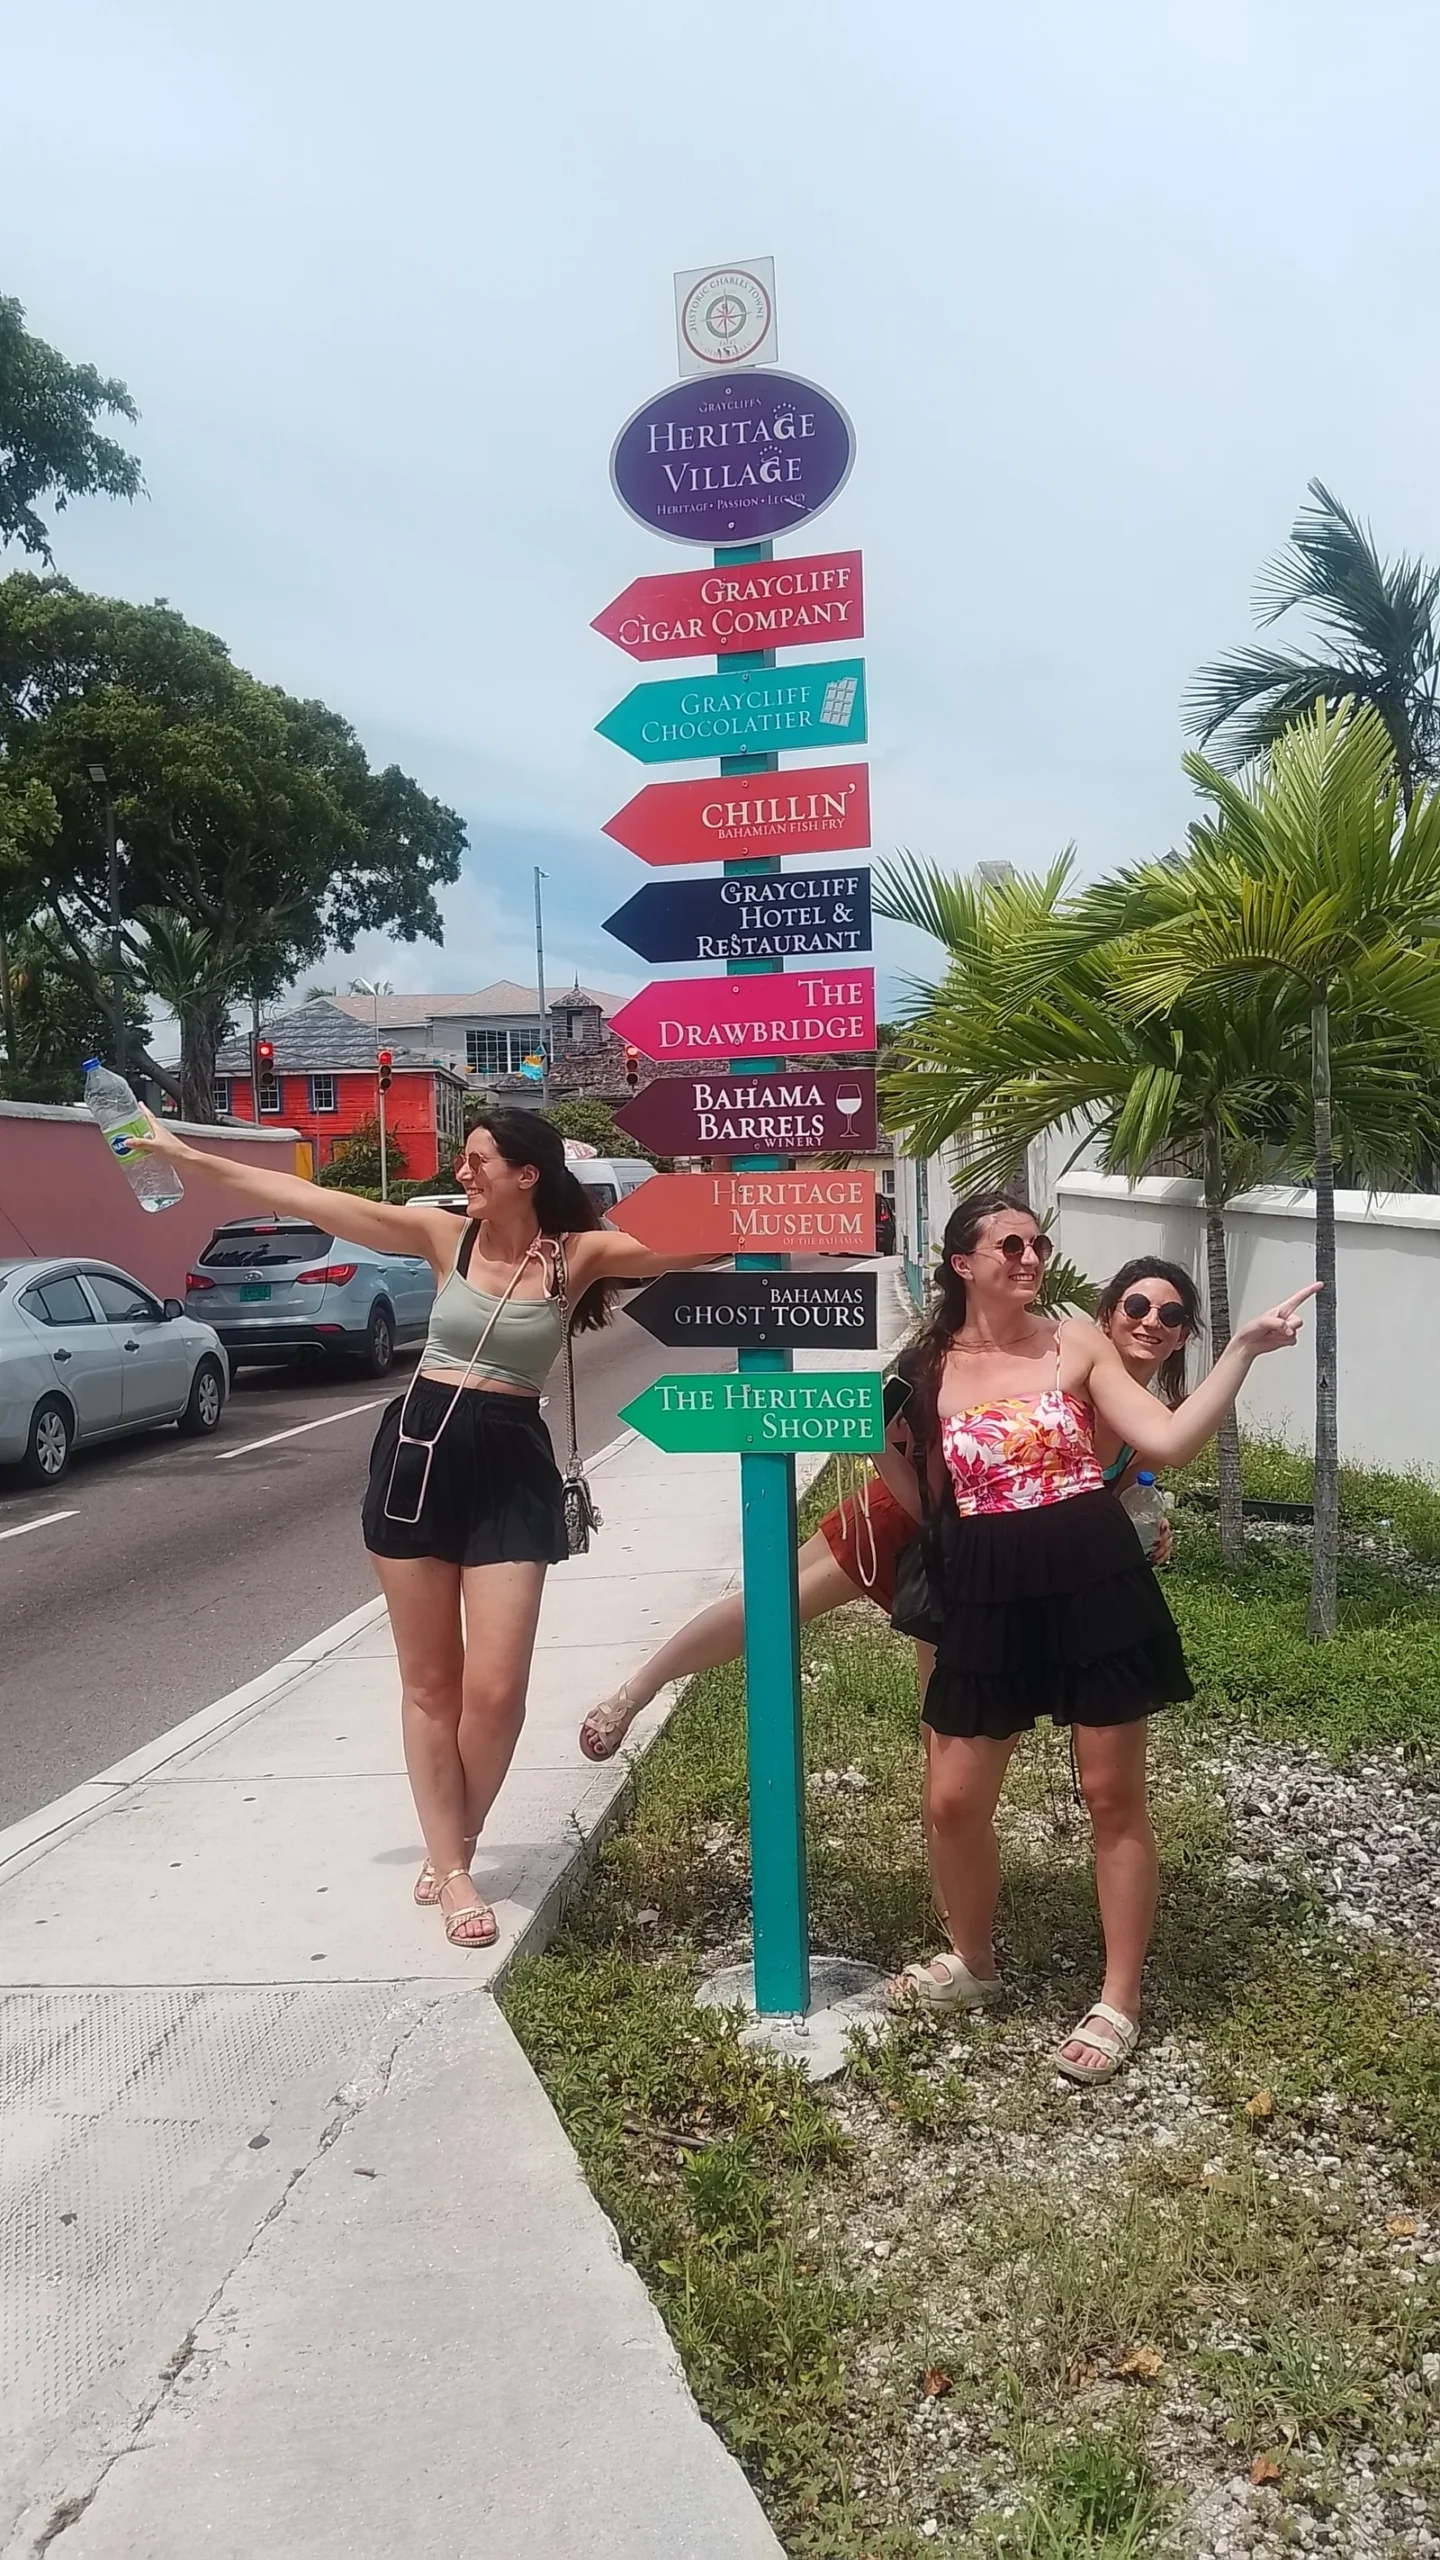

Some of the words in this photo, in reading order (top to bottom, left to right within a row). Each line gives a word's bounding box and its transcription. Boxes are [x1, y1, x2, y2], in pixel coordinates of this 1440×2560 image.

[688, 285, 710, 331] HISTORIC
[709, 277, 748, 289] CHARLES
[748, 287, 764, 320] TOWNE
[647, 410, 816, 454] HERITAGE
[661, 455, 803, 494] VILLAGE
[657, 503, 709, 516] HERITAGE
[717, 497, 759, 510] PASSION
[768, 492, 806, 505] LEGACY
[701, 567, 851, 605] GRAYCLIFF
[619, 617, 707, 645] CIGAR
[711, 600, 853, 636] COMPANY
[681, 686, 811, 715] GRAYCLIFF
[641, 710, 814, 743] CHOCOLATIER
[718, 823, 787, 839] BAHAMIAN
[790, 820, 818, 833] FISH
[821, 818, 846, 830] FRY
[720, 877, 859, 904] GRAYCLIFF
[738, 904, 826, 930] HOTEL
[832, 902, 854, 923] &
[696, 930, 861, 958] RESTAURANT
[797, 978, 863, 1008] THE
[658, 1015, 864, 1048] DRAWBRIDGE
[692, 1083, 825, 1111] BAHAMA
[697, 1113, 825, 1141] BARRELS
[764, 1136, 825, 1148] WINERY
[712, 1179, 864, 1206] HERITAGE
[729, 1208, 864, 1236] MUSEUM
[783, 1237, 794, 1245] OF
[799, 1237, 816, 1245] THE
[819, 1237, 864, 1245] BAHAMAS
[769, 1288, 864, 1304] BAHAMAS
[674, 1305, 765, 1326] GHOST
[771, 1306, 865, 1327] TOURS
[654, 1385, 714, 1411] THE
[723, 1383, 872, 1410] HERITAGE
[762, 1412, 874, 1439] SHOPPE
